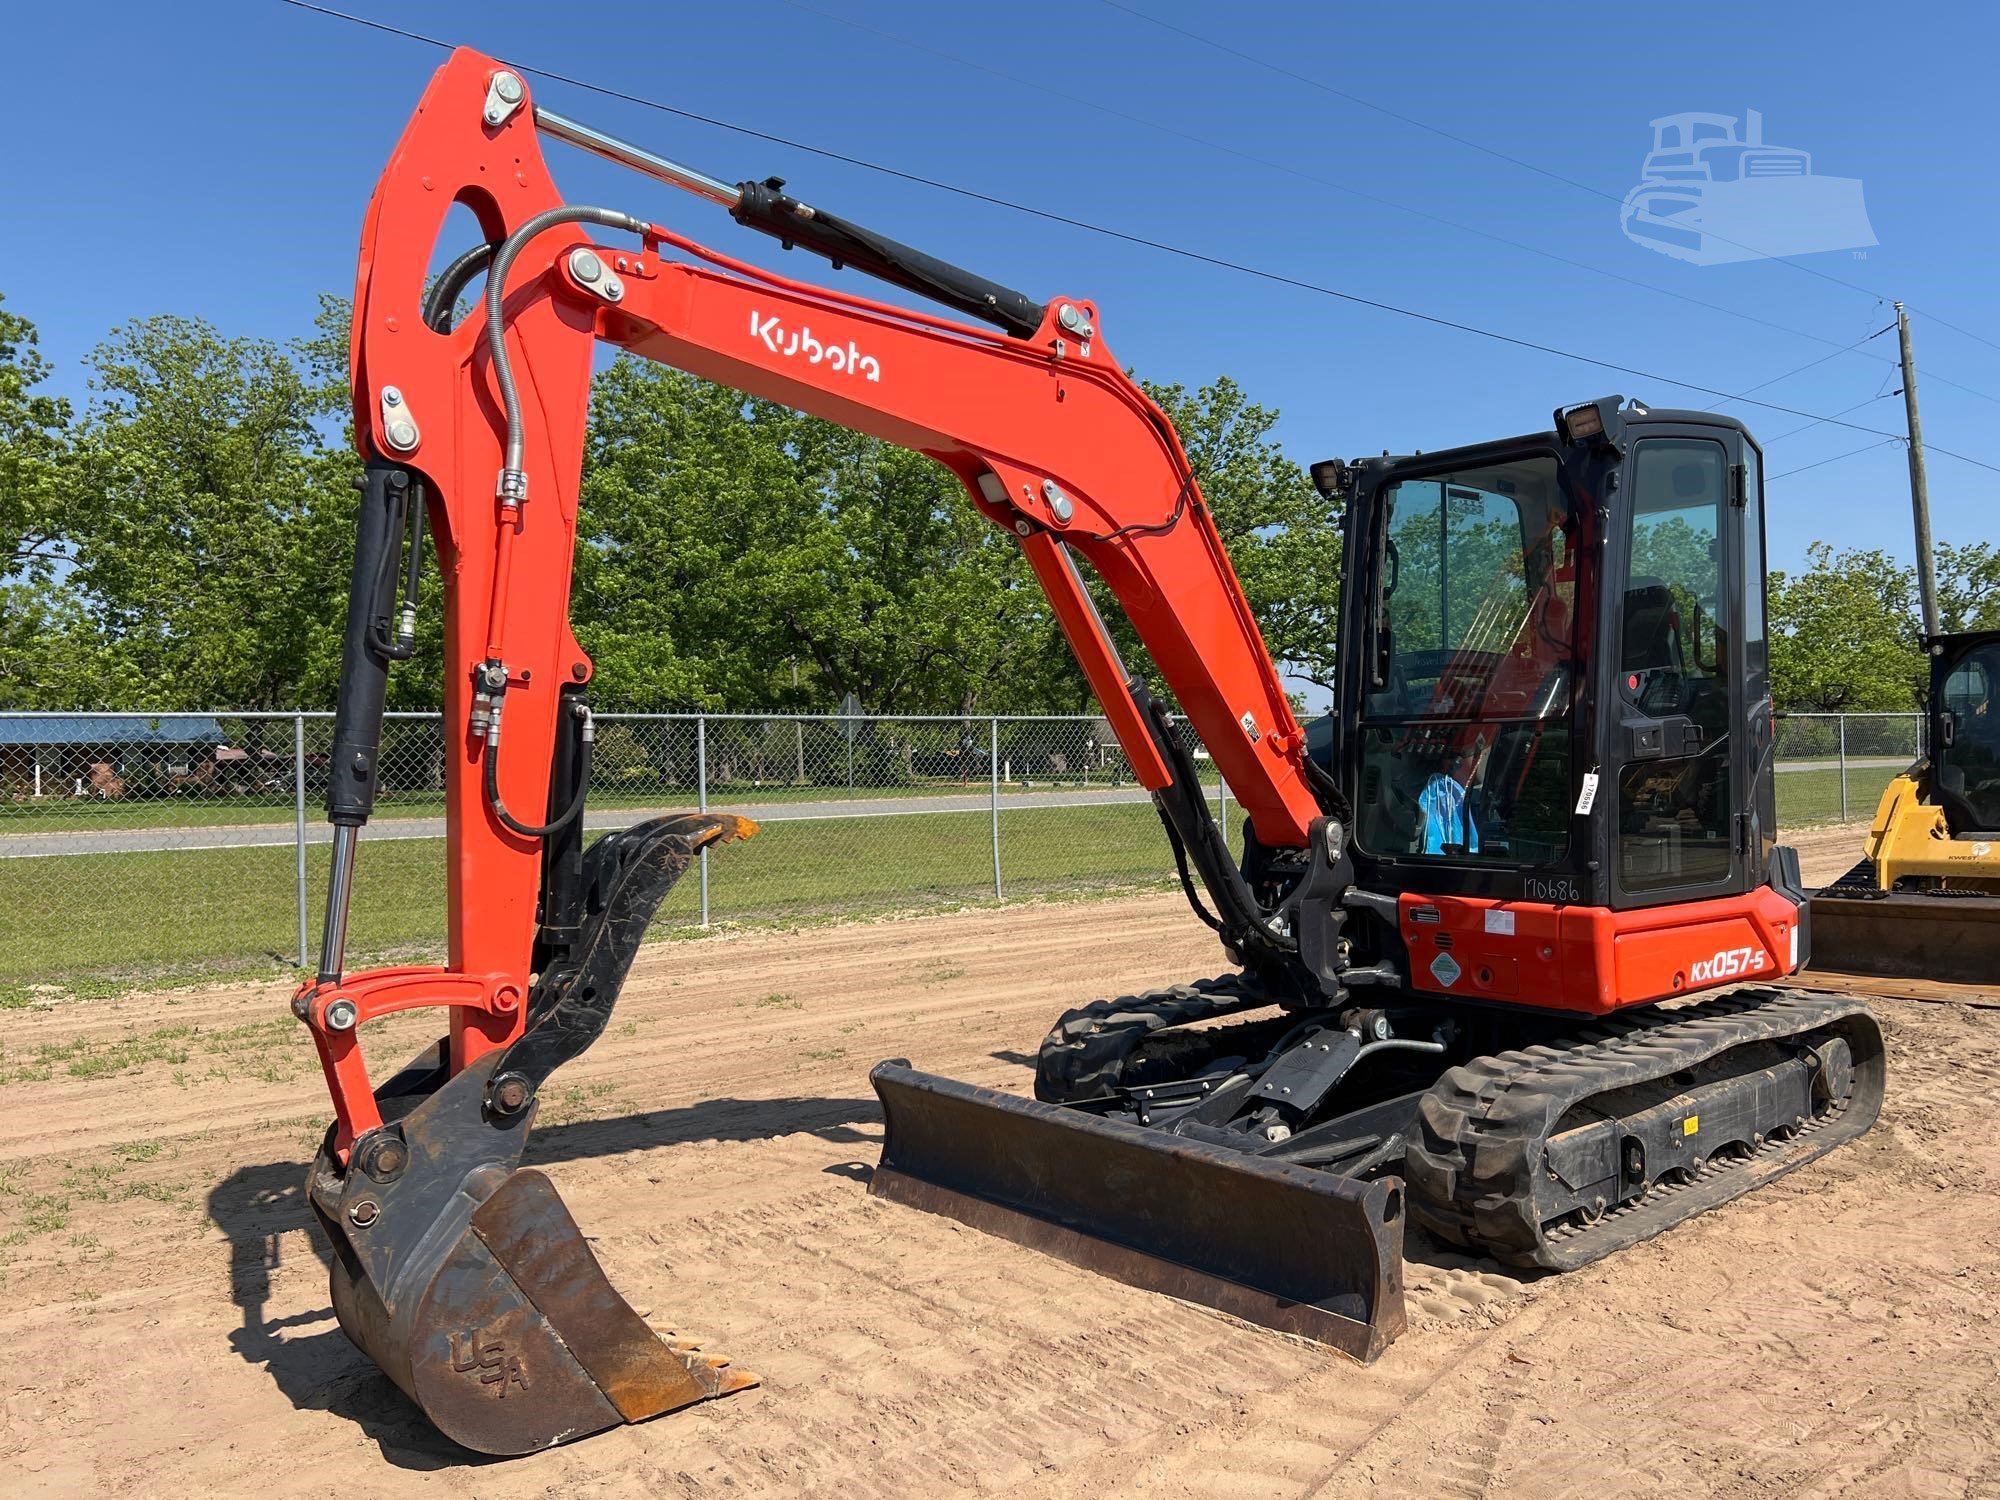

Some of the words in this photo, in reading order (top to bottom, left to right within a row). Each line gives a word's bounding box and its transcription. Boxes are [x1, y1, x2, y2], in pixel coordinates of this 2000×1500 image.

[750, 310, 880, 383] Kubota
[1581, 783, 1595, 810] 170686
[1524, 877, 1580, 901] 170686
[1690, 947, 1765, 982] KX057-5
[451, 1327, 528, 1399] USA
